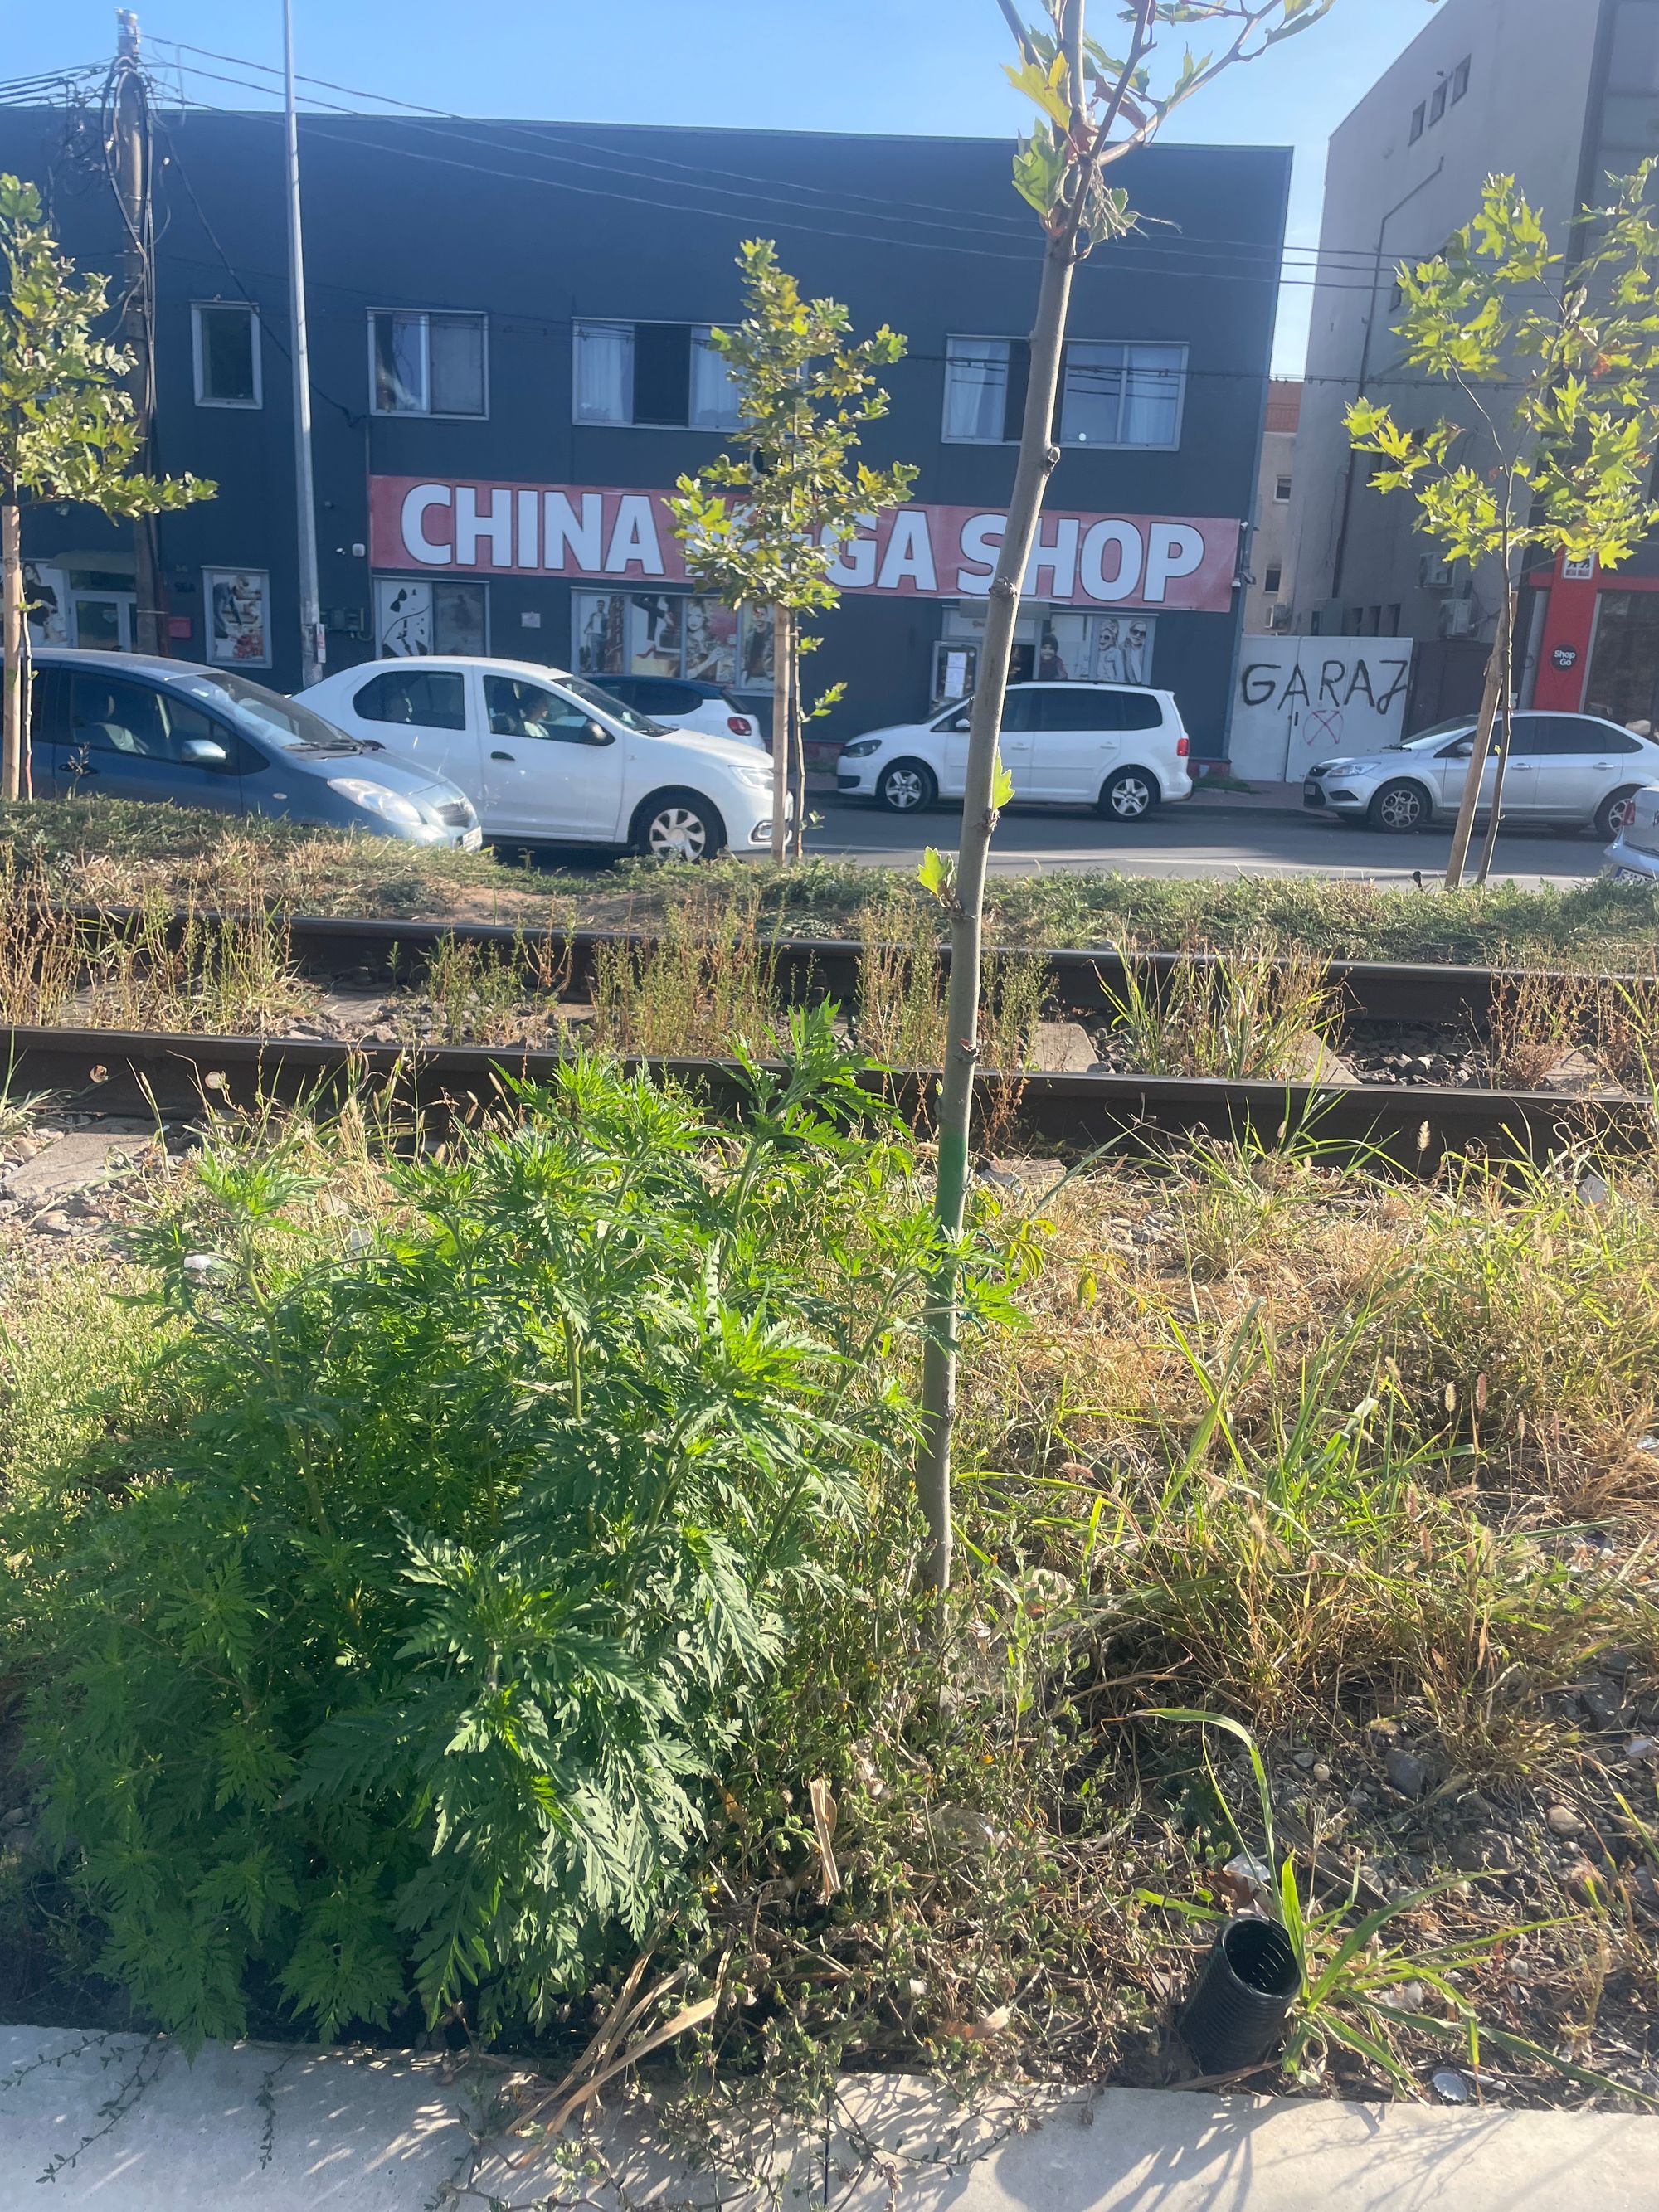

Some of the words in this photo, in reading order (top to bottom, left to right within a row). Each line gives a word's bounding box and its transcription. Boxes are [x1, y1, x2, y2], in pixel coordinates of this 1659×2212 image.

[400, 482, 664, 576] CHINA
[956, 513, 1205, 603] SHOP
[1554, 649, 1576, 659] Shop
[1559, 658, 1572, 666] Go
